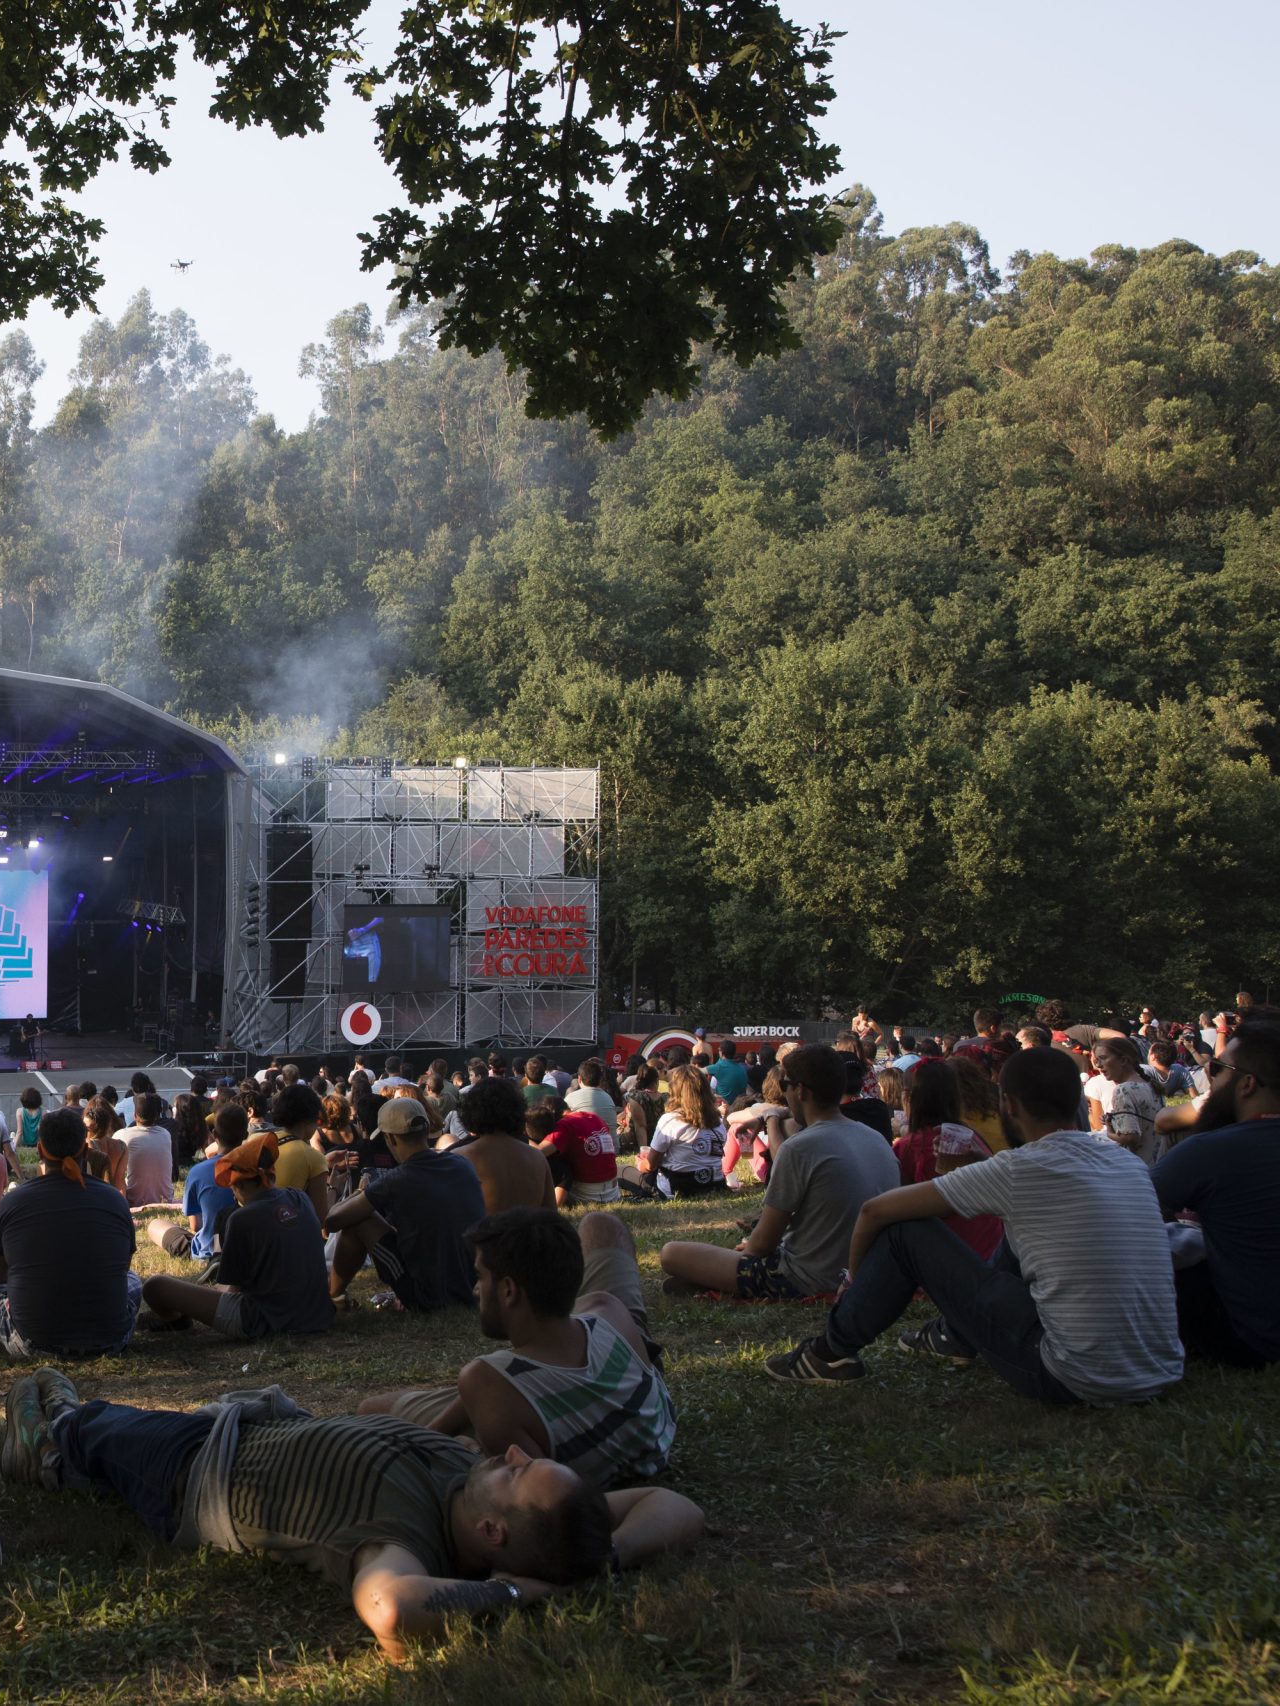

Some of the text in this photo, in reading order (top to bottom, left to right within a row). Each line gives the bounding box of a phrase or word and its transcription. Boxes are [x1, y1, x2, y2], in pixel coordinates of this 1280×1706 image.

[485, 905, 587, 924] VODAFONE
[484, 927, 587, 951] PAREDES
[484, 952, 587, 977] DE COURA
[998, 992, 1046, 1005] JAMESON
[733, 1026, 800, 1037] SUPER BOCK
